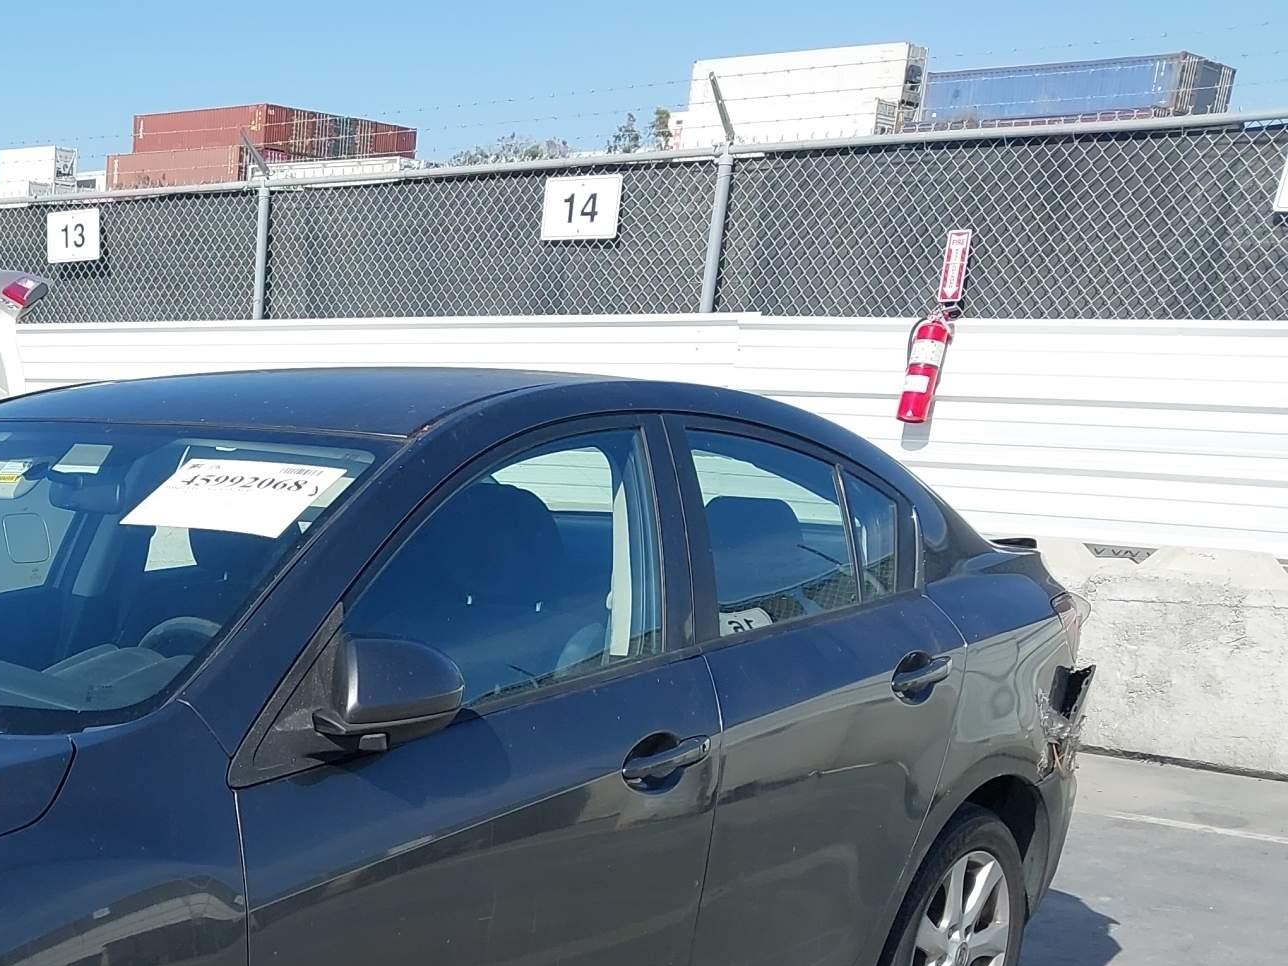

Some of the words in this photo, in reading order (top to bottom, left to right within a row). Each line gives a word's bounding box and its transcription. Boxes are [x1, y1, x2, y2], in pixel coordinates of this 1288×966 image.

[564, 193, 598, 223] 14
[61, 223, 85, 248] 13
[181, 474, 308, 491] 45992068
